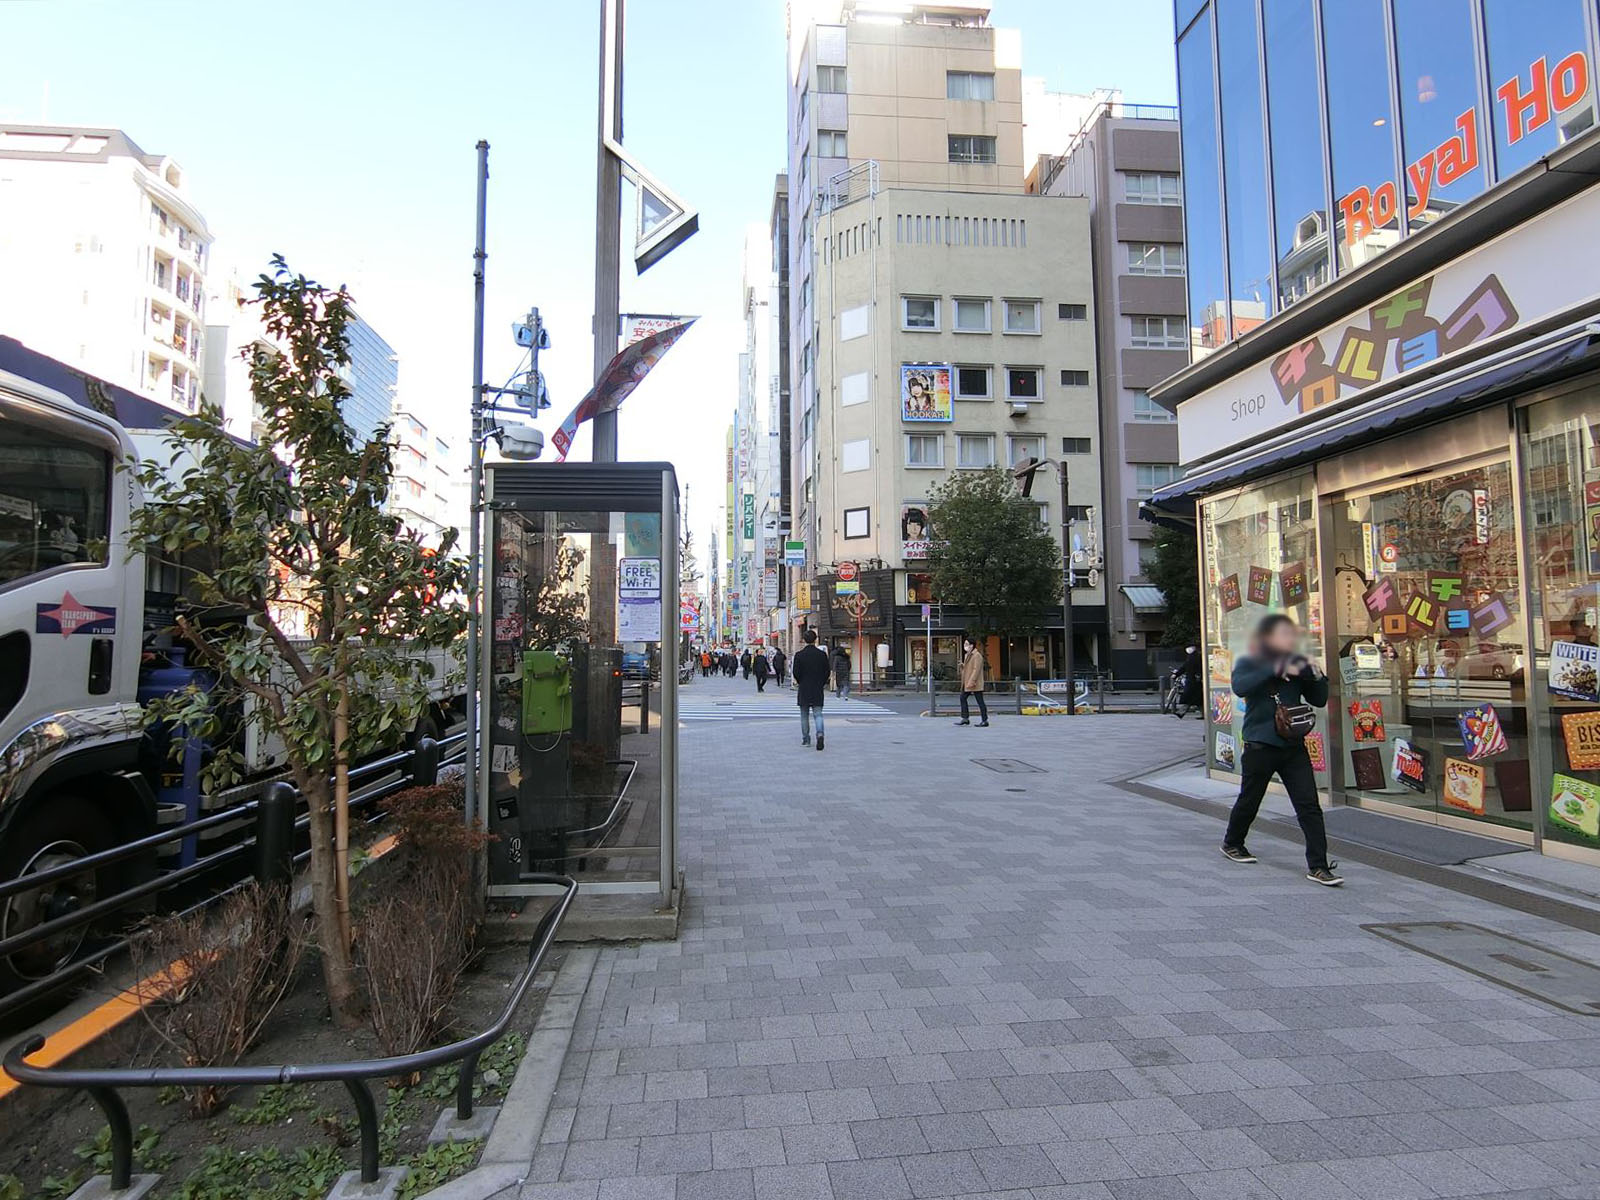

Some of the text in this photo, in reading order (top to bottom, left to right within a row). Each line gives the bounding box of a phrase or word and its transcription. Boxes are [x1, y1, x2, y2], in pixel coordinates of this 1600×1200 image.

[1339, 107, 1479, 248] Royal
[1231, 392, 1266, 421] Shop
[905, 411, 945, 419] HOOKAH
[625, 568, 652, 577] FREE
[626, 578, 652, 587] Wi-Fi
[1557, 643, 1597, 663] WHITE
